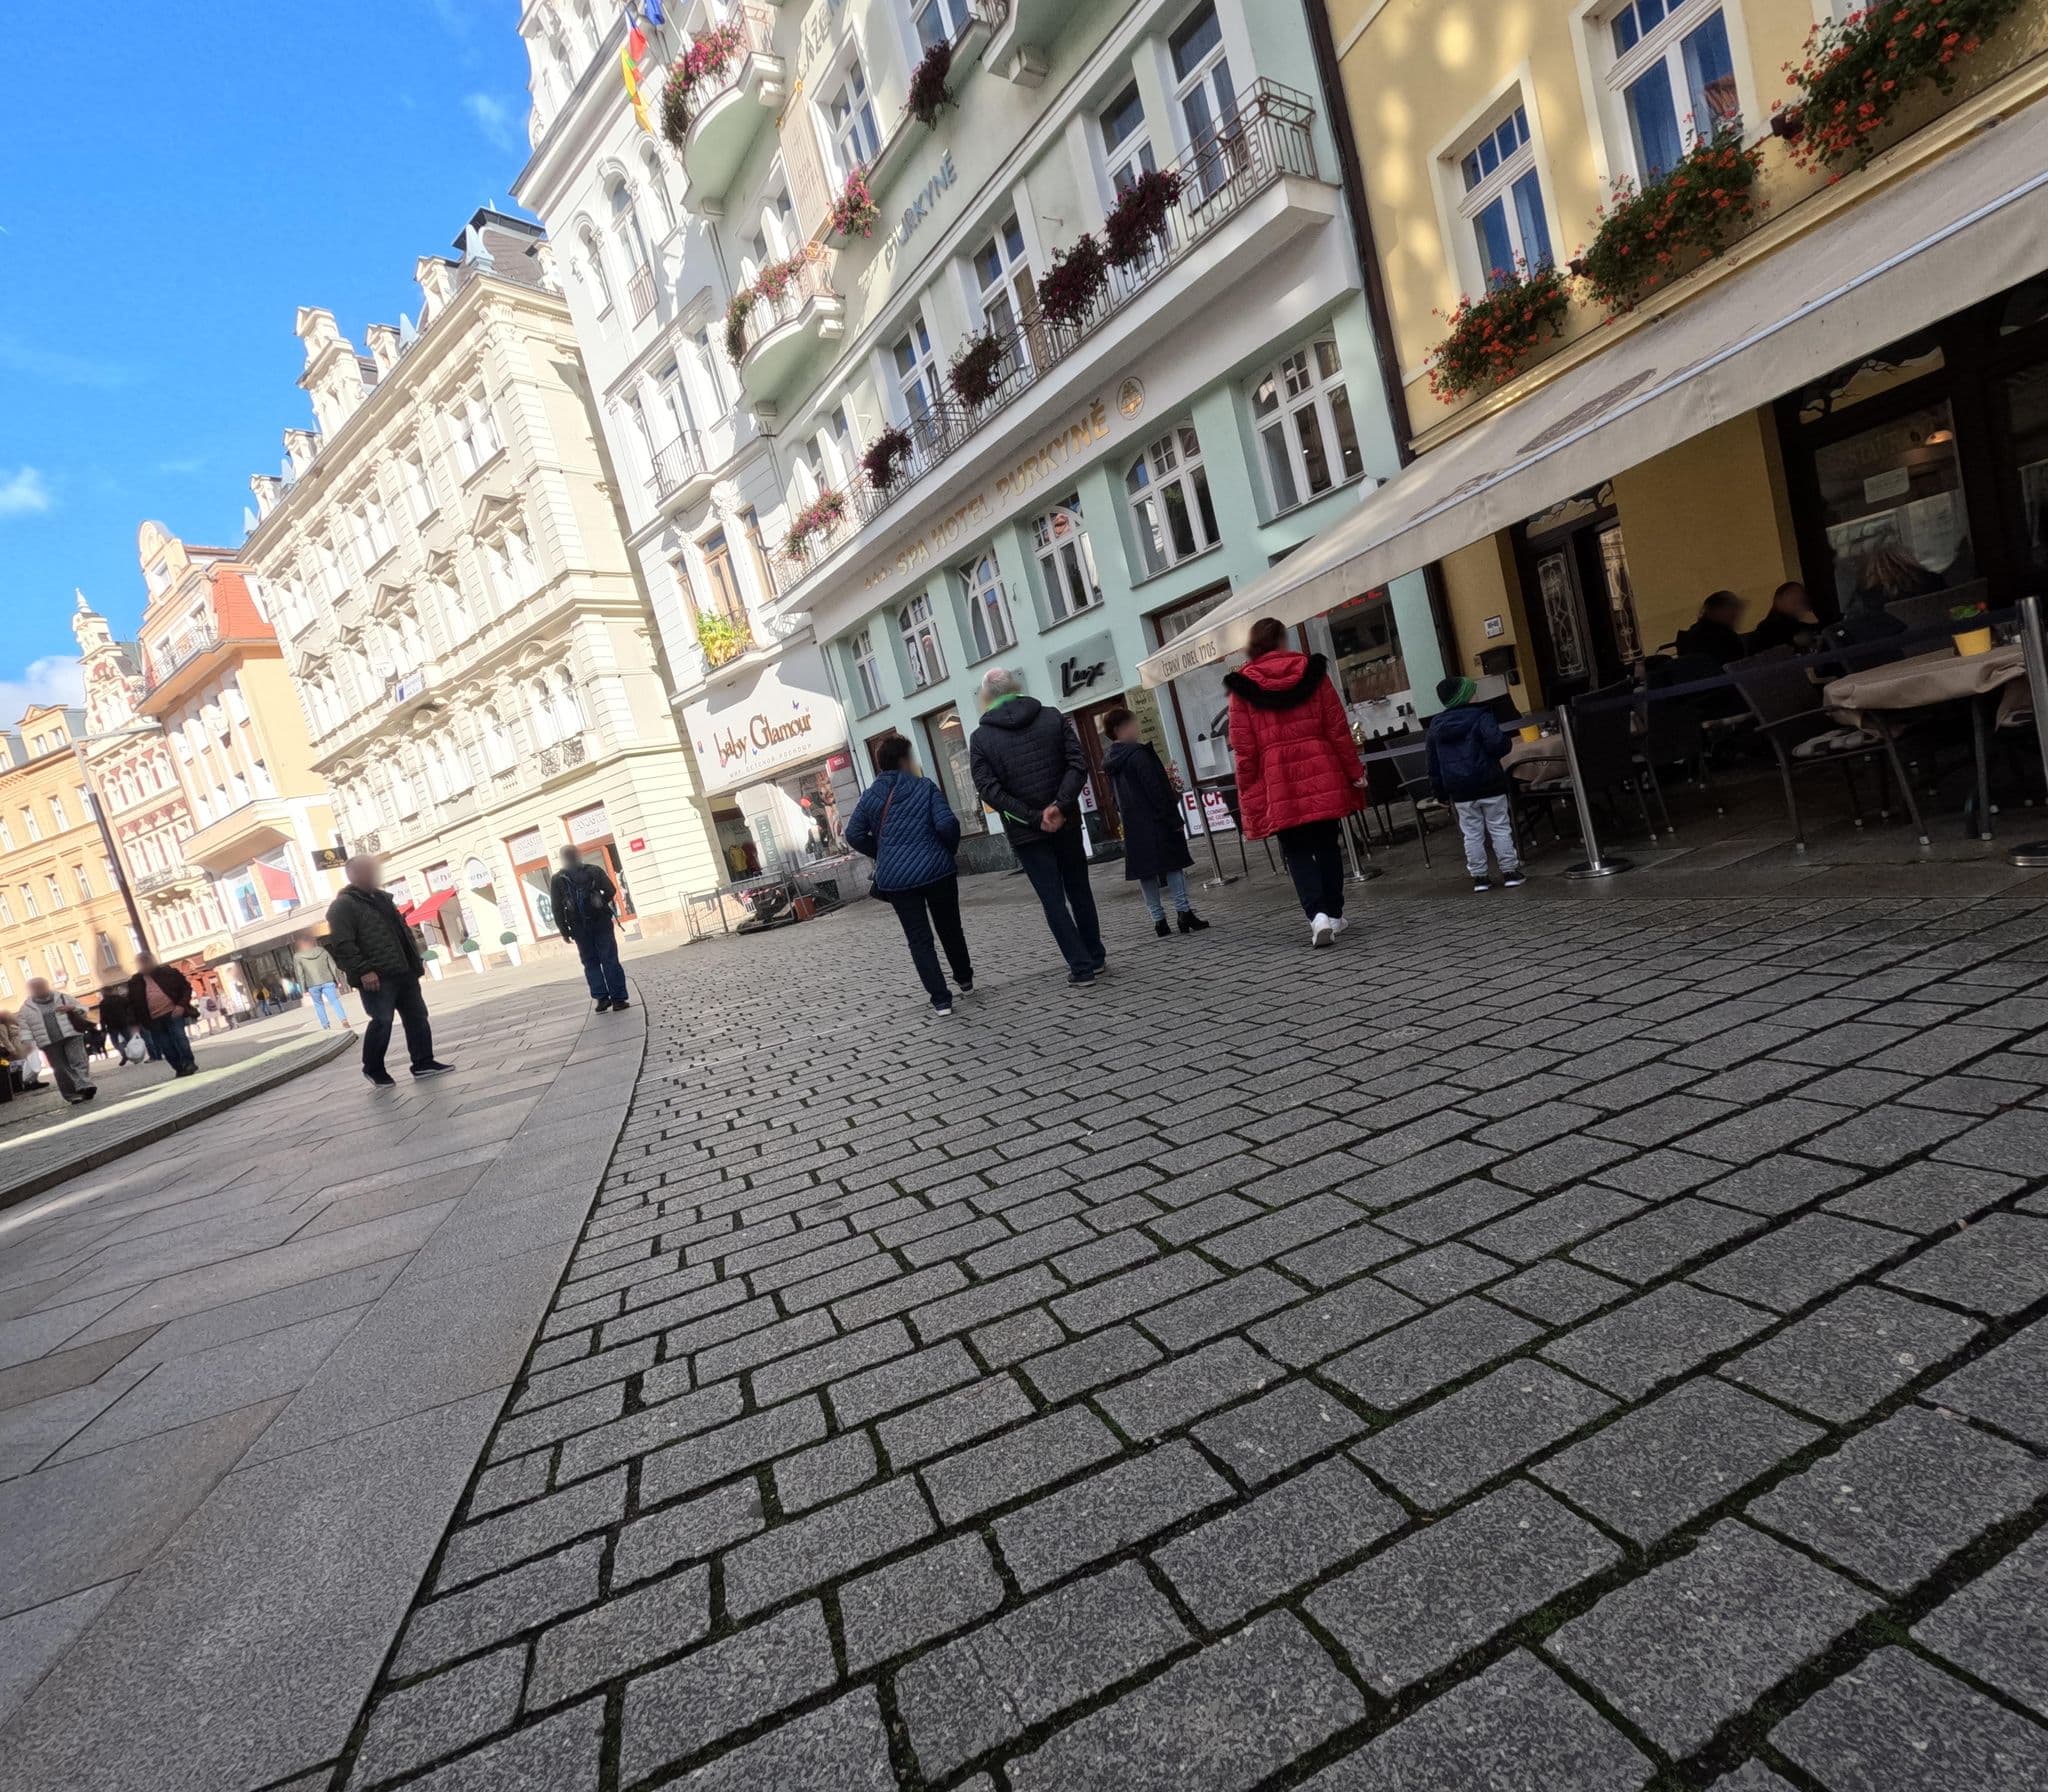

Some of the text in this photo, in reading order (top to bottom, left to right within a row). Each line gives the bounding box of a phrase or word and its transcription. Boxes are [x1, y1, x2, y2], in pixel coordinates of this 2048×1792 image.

[896, 397, 1111, 576] SPA HOTEL PURKYNĚ
[1182, 650, 1199, 668] OREL
[1199, 641, 1217, 664] 1705
[713, 713, 813, 764] baby Glamour
